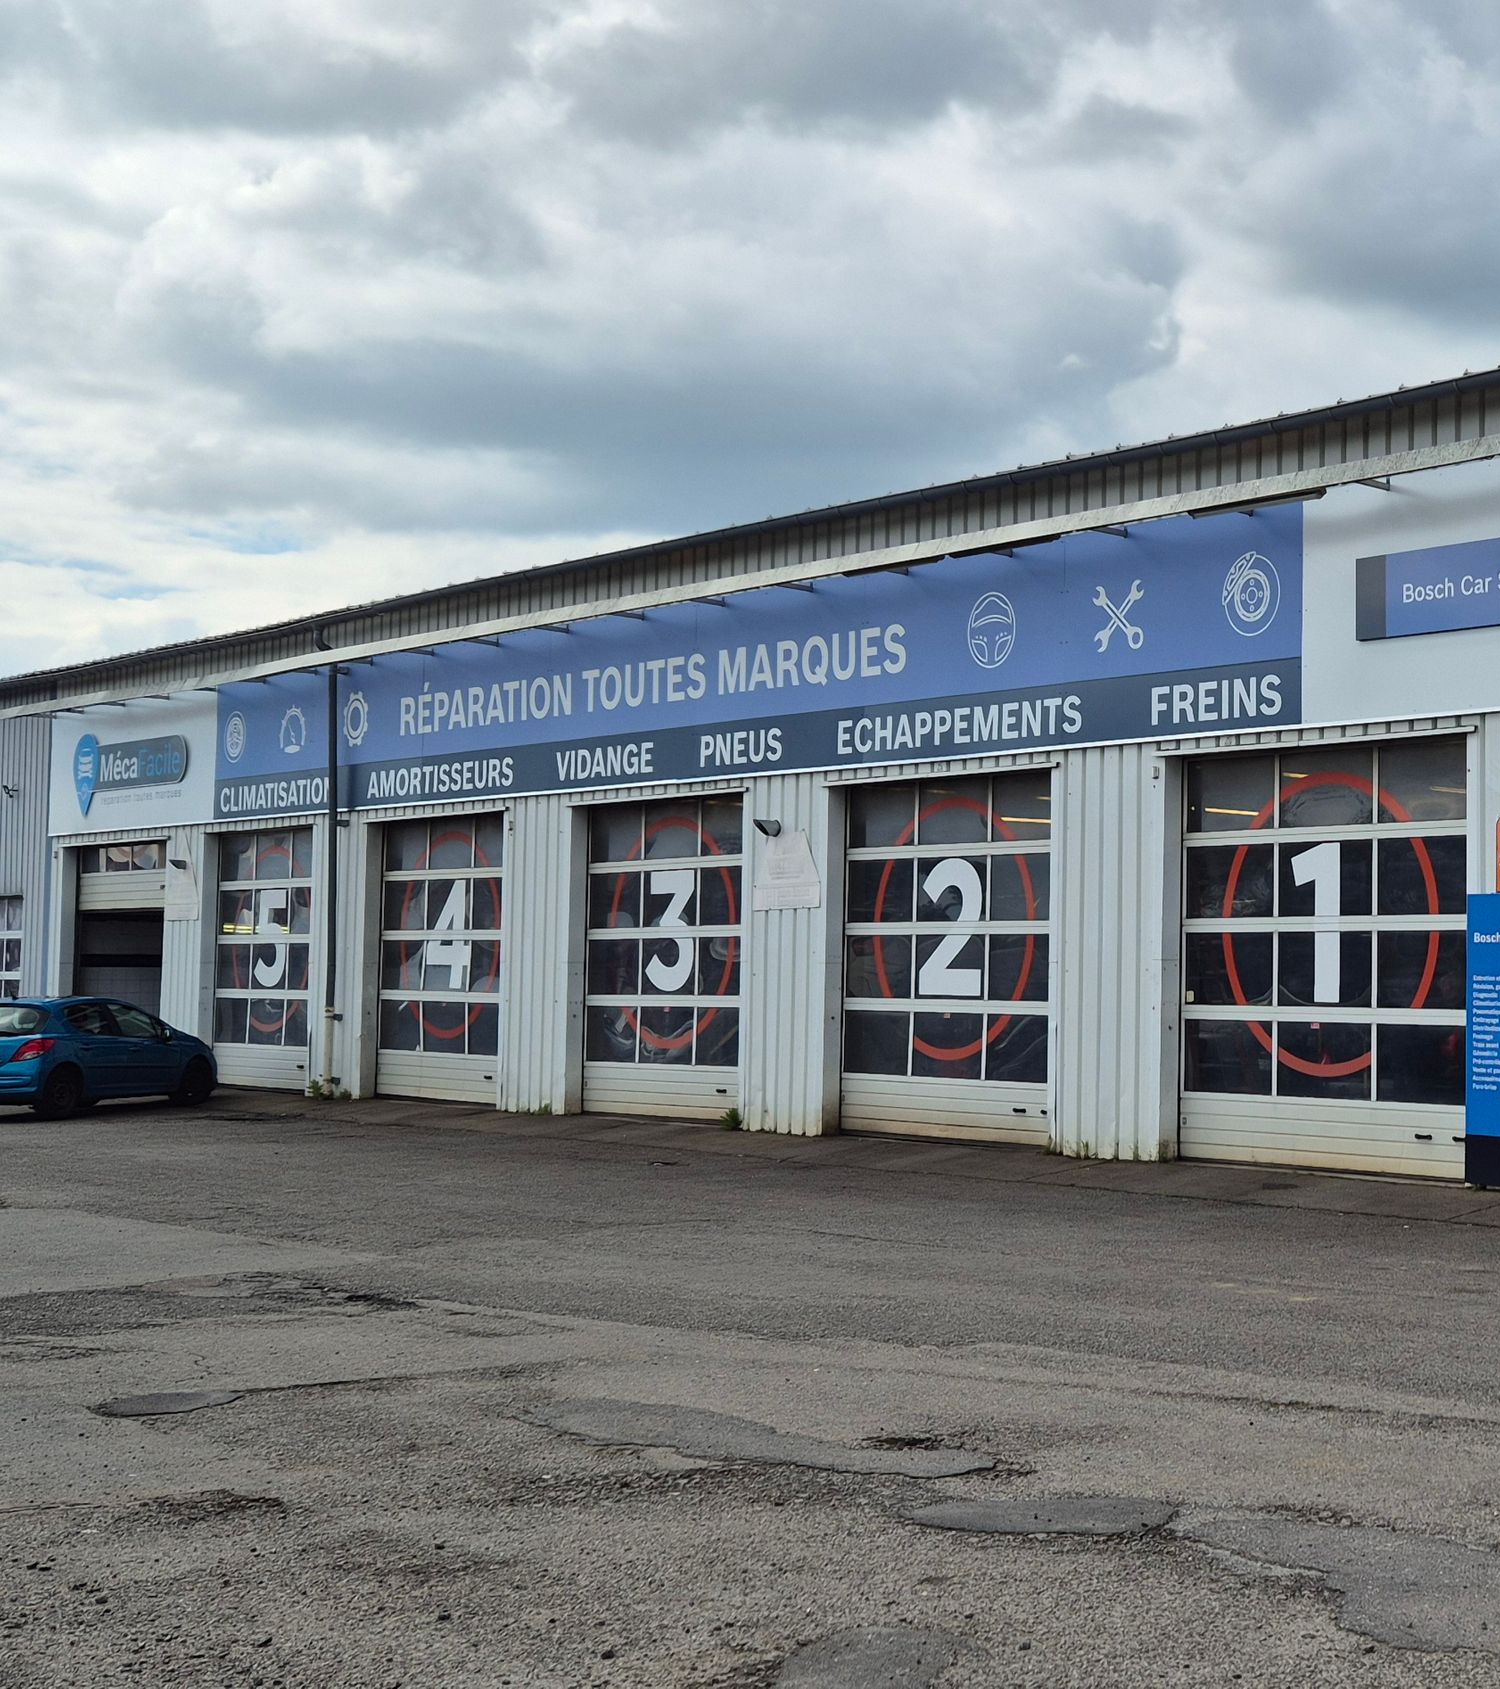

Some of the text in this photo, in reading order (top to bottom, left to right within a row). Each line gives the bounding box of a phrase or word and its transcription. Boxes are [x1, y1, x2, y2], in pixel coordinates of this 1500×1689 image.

[1402, 577, 1454, 603] Bosch
[1461, 575, 1492, 595] Car
[400, 623, 906, 737] RÉPARATION TOUTES MARQUES
[1151, 674, 1282, 726] FREINS
[556, 742, 654, 782] VIDANGE
[699, 727, 782, 768] PNEUS
[837, 695, 1082, 755] ECHAPPEMENTS
[367, 757, 514, 799] AMORTISSEURS
[254, 889, 286, 988] 5
[426, 880, 470, 989] 4
[645, 870, 695, 992] 3
[918, 857, 982, 997] 2
[1290, 842, 1340, 1003] 1
